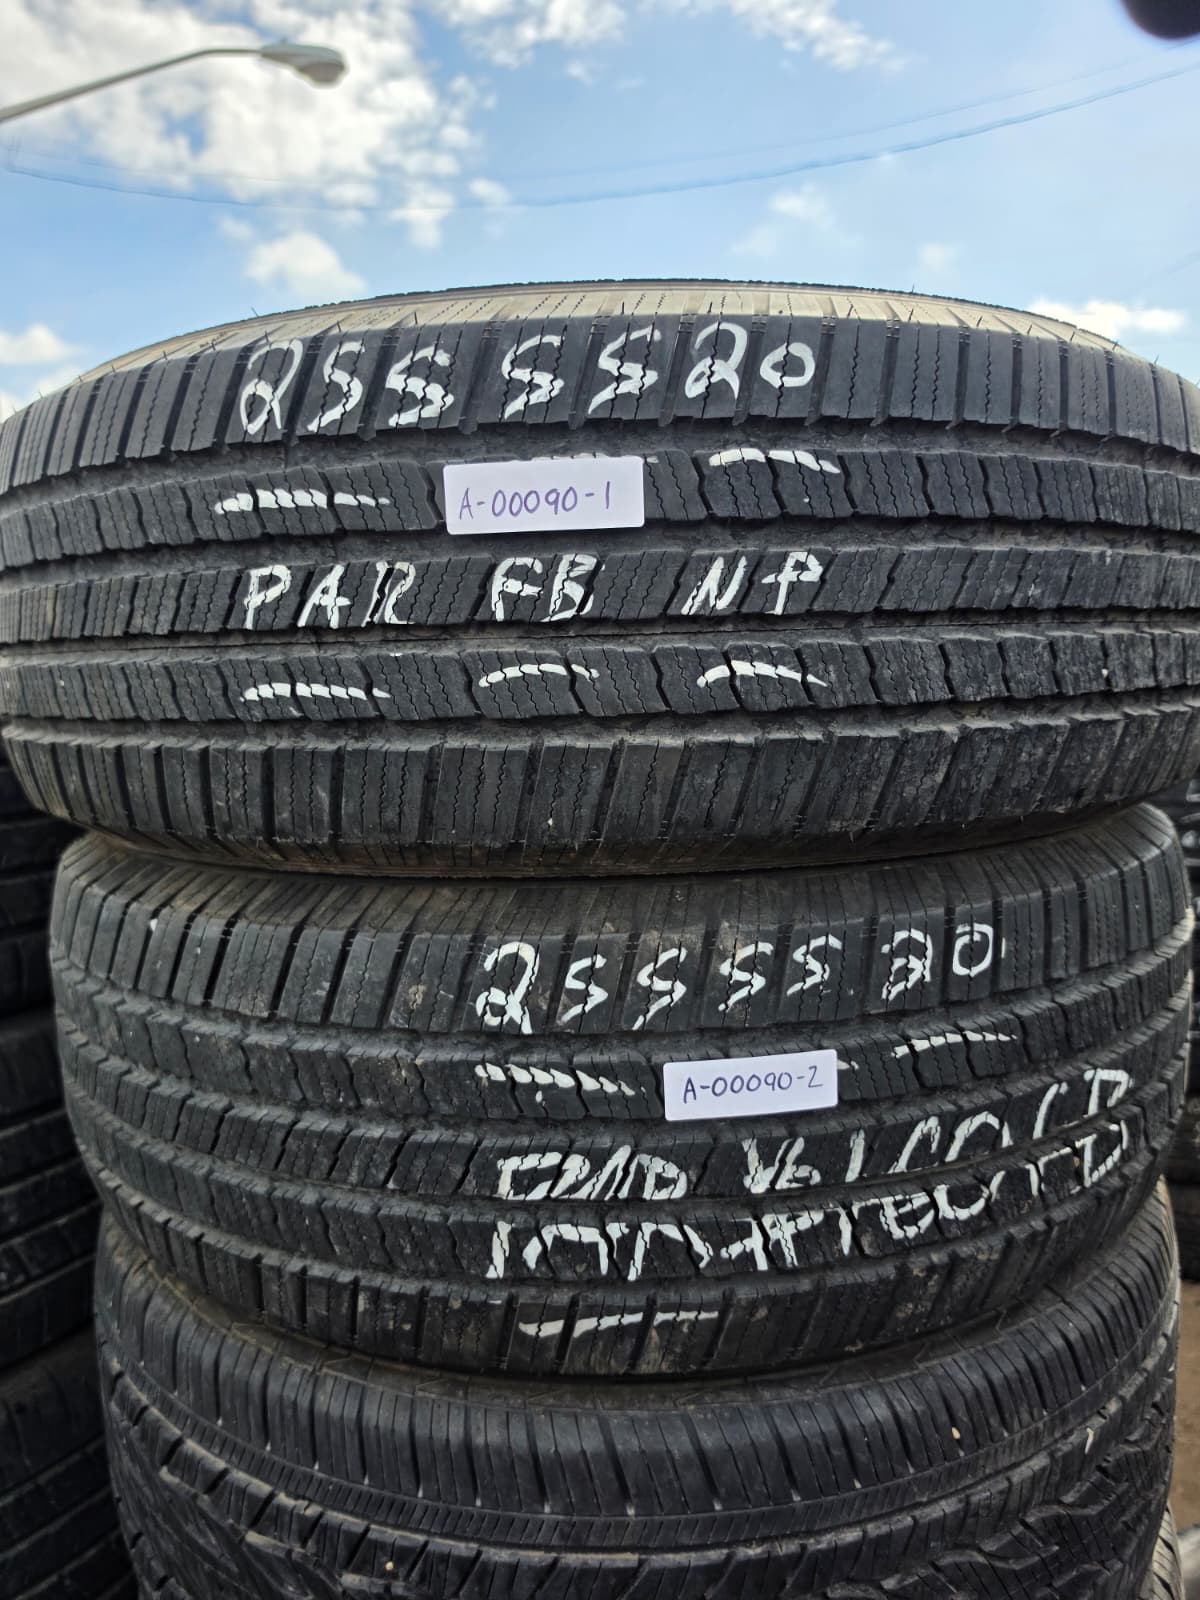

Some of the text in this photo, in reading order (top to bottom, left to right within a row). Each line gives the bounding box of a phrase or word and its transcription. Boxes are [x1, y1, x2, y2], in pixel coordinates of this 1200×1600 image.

[240, 338, 455, 434] 255
[685, 321, 817, 399] 20
[458, 480, 612, 521] A-00090-1
[244, 562, 415, 629] PAR
[682, 1064, 825, 1104] A-00090-2
